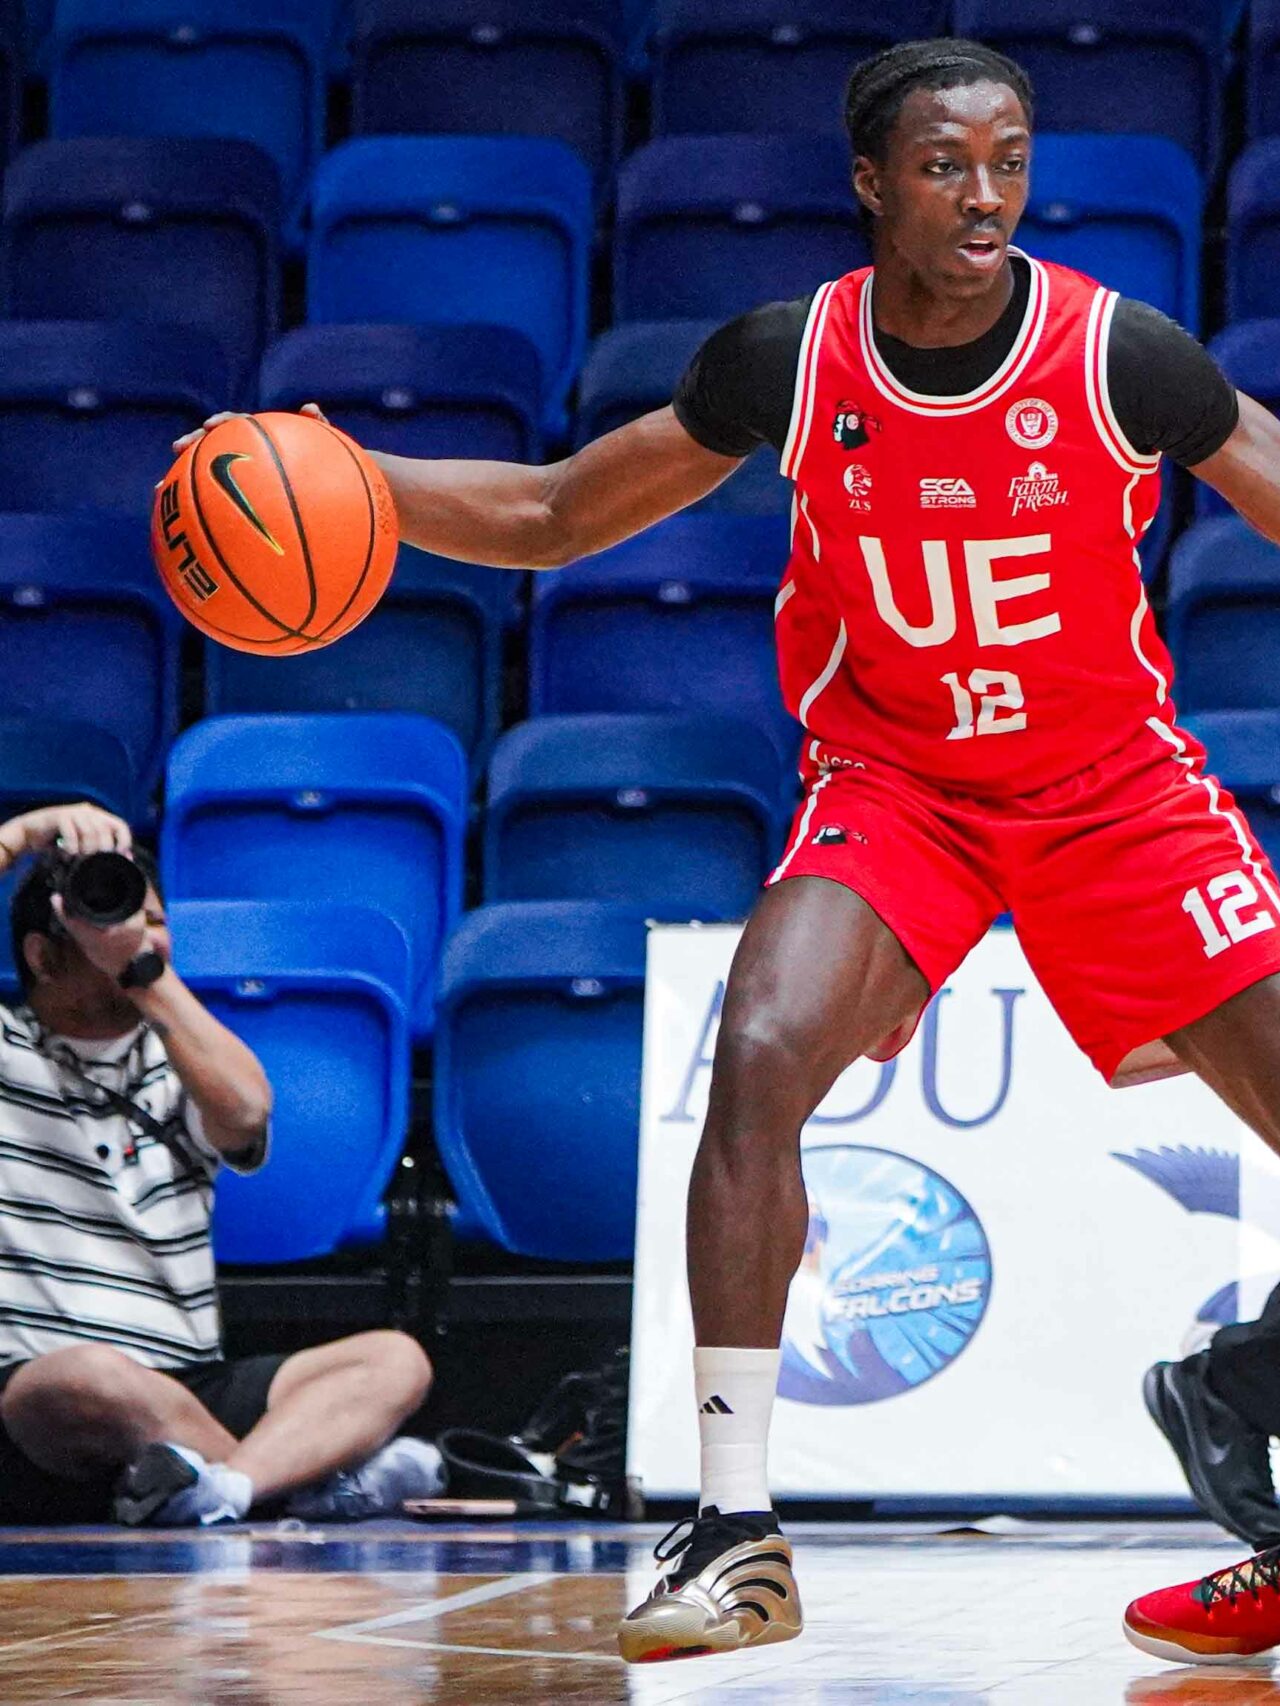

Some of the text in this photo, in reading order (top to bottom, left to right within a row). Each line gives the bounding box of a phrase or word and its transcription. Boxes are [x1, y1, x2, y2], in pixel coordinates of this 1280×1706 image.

[161, 480, 220, 601] ELITE
[920, 496, 976, 504] STRONG
[858, 534, 1062, 648] UE
[940, 668, 1028, 740] 12
[1181, 869, 1276, 959] 12
